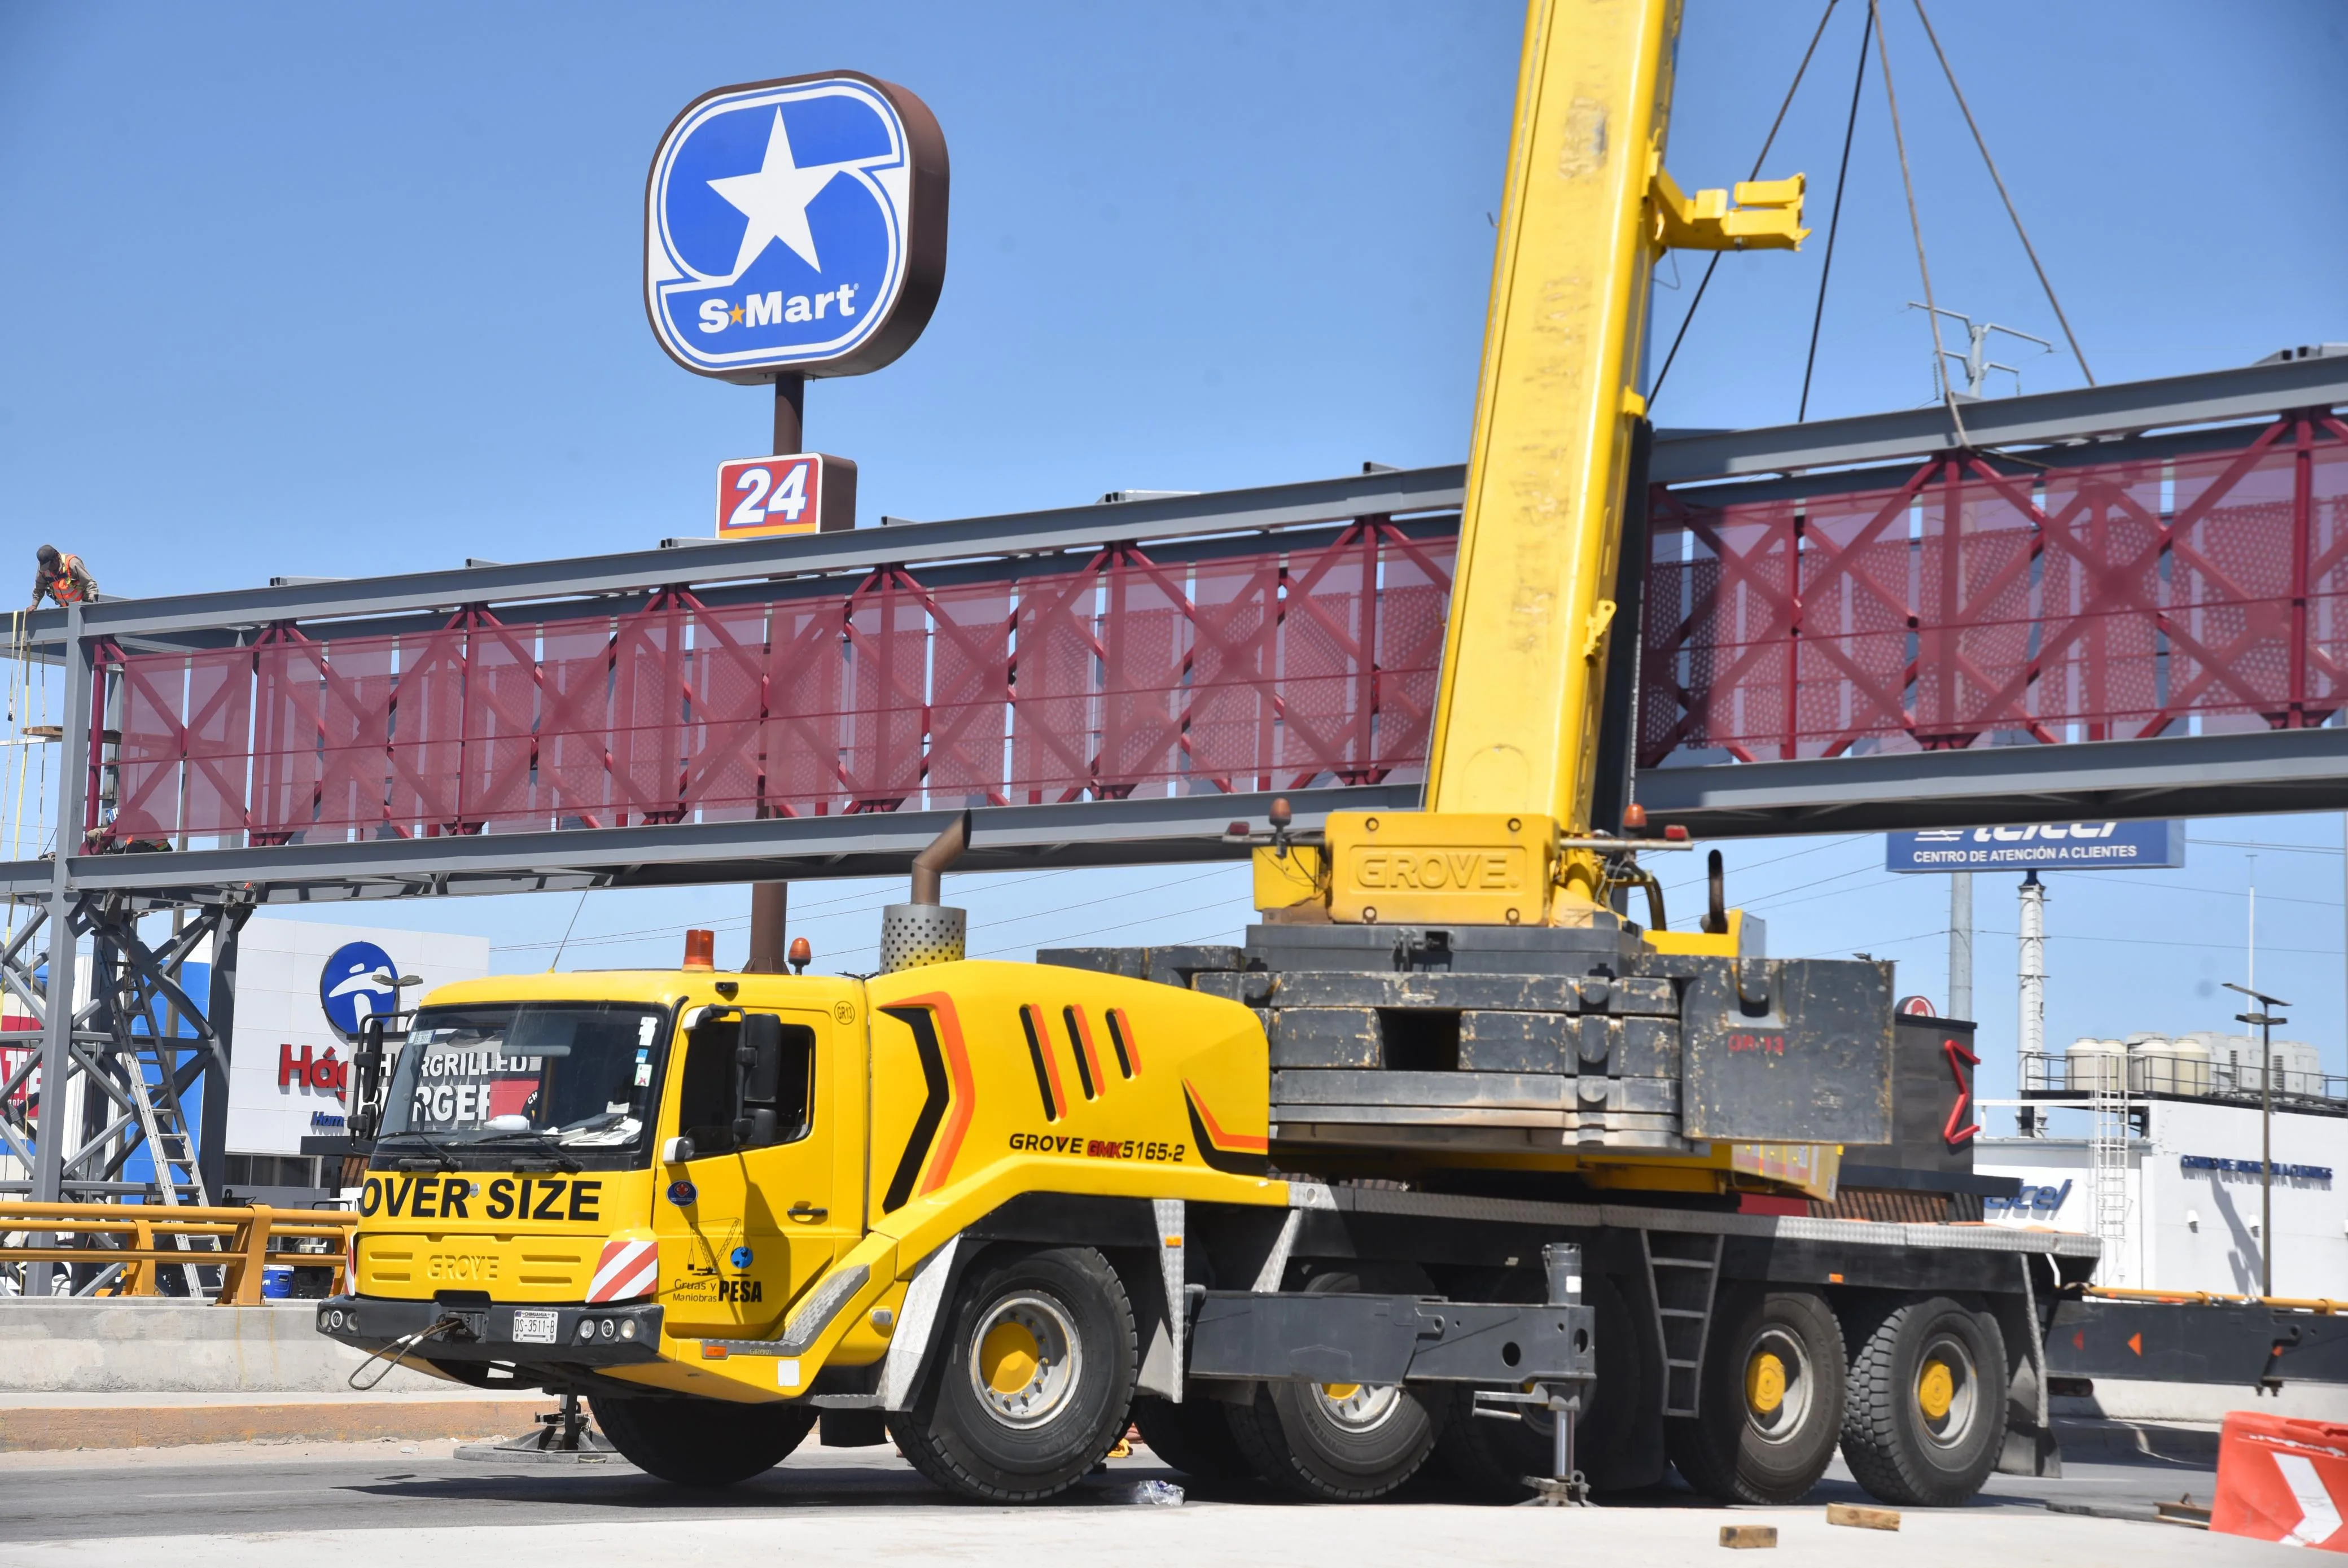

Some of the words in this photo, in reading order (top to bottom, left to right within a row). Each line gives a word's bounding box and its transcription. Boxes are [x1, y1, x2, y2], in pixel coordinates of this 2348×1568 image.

[728, 462, 810, 527] 24
[1913, 851, 1966, 862] CENTRO
[1969, 851, 1987, 862] DE
[1989, 846, 2057, 861] ATENCIÓN
[2058, 847, 2069, 859] A
[2071, 845, 2137, 858] CLIENTES
[837, 1006, 852, 1019] GR13
[1009, 1133, 1084, 1154] GROVE
[360, 1178, 471, 1218] OVER
[486, 1179, 602, 1221] SIZE
[427, 1254, 500, 1281] GROVE
[674, 1278, 707, 1290] Gruas
[710, 1282, 717, 1291] y
[718, 1280, 763, 1303] PESA
[672, 1293, 717, 1303] Maniobras
[515, 1319, 555, 1333] DS-3511-B
